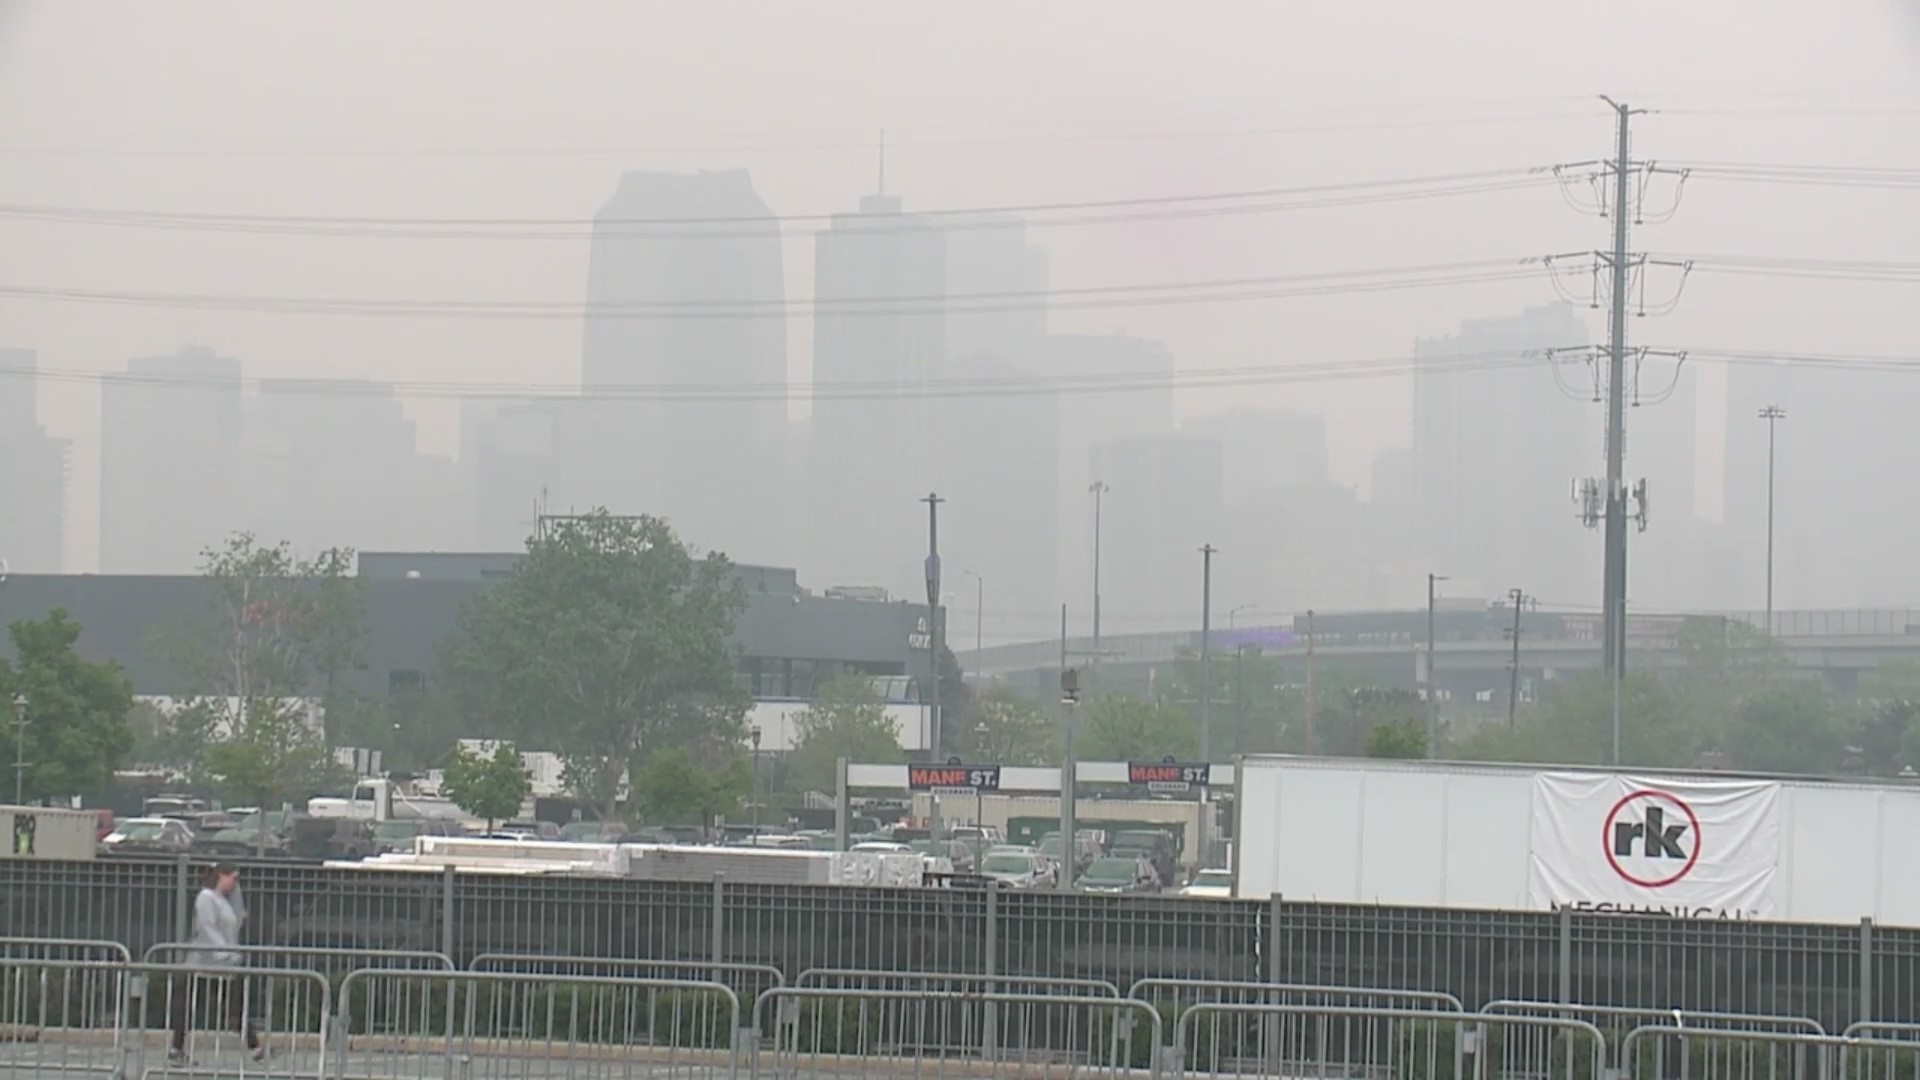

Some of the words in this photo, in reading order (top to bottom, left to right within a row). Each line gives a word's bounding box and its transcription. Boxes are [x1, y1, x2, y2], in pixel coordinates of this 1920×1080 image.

[970, 769, 997, 787] ST.
[1183, 767, 1207, 782] ST.
[1614, 806, 1689, 860] rk
